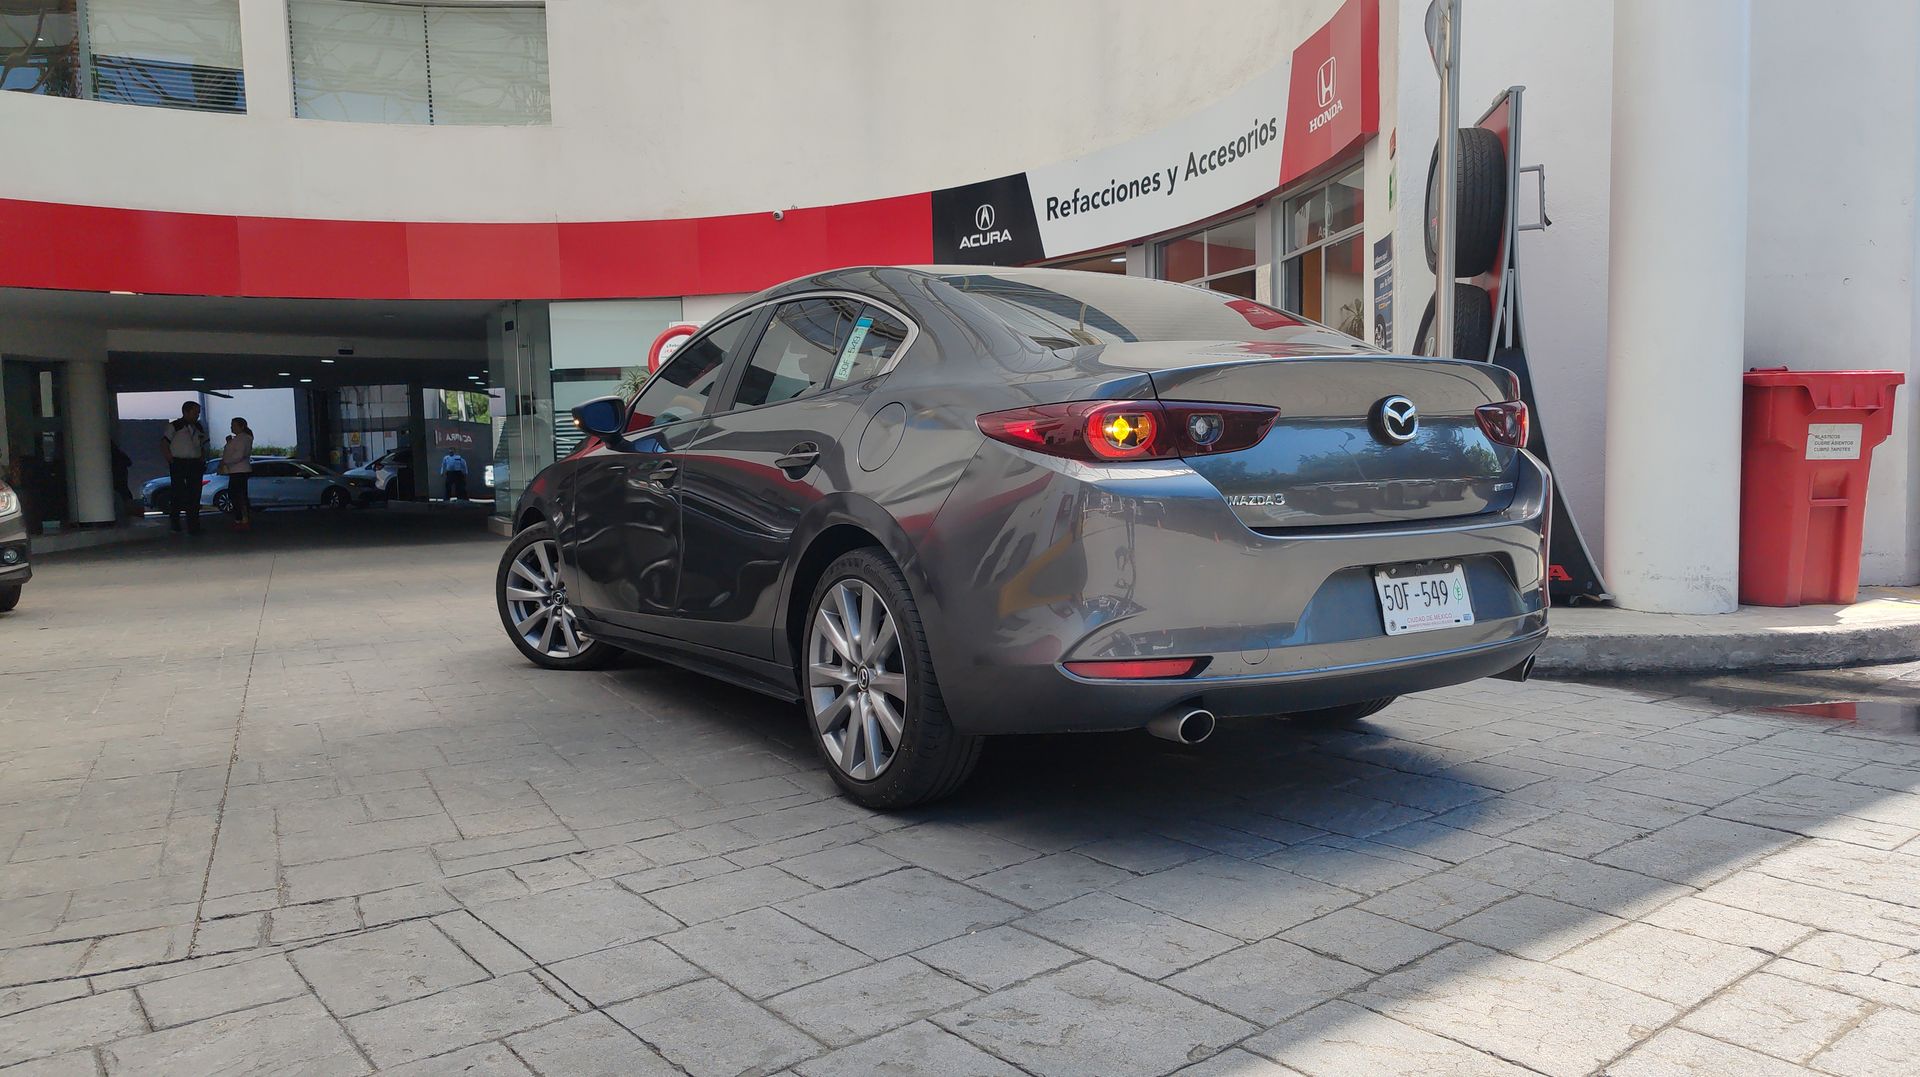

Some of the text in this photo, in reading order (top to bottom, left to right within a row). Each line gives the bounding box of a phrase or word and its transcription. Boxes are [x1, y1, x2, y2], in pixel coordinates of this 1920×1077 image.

[1309, 100, 1343, 133] HONDA
[1046, 117, 1277, 221] Refacciones y Accesorios
[959, 229, 1012, 250] ACURA
[1225, 493, 1286, 506] MAZDA3
[1383, 580, 1449, 611] 50F-549
